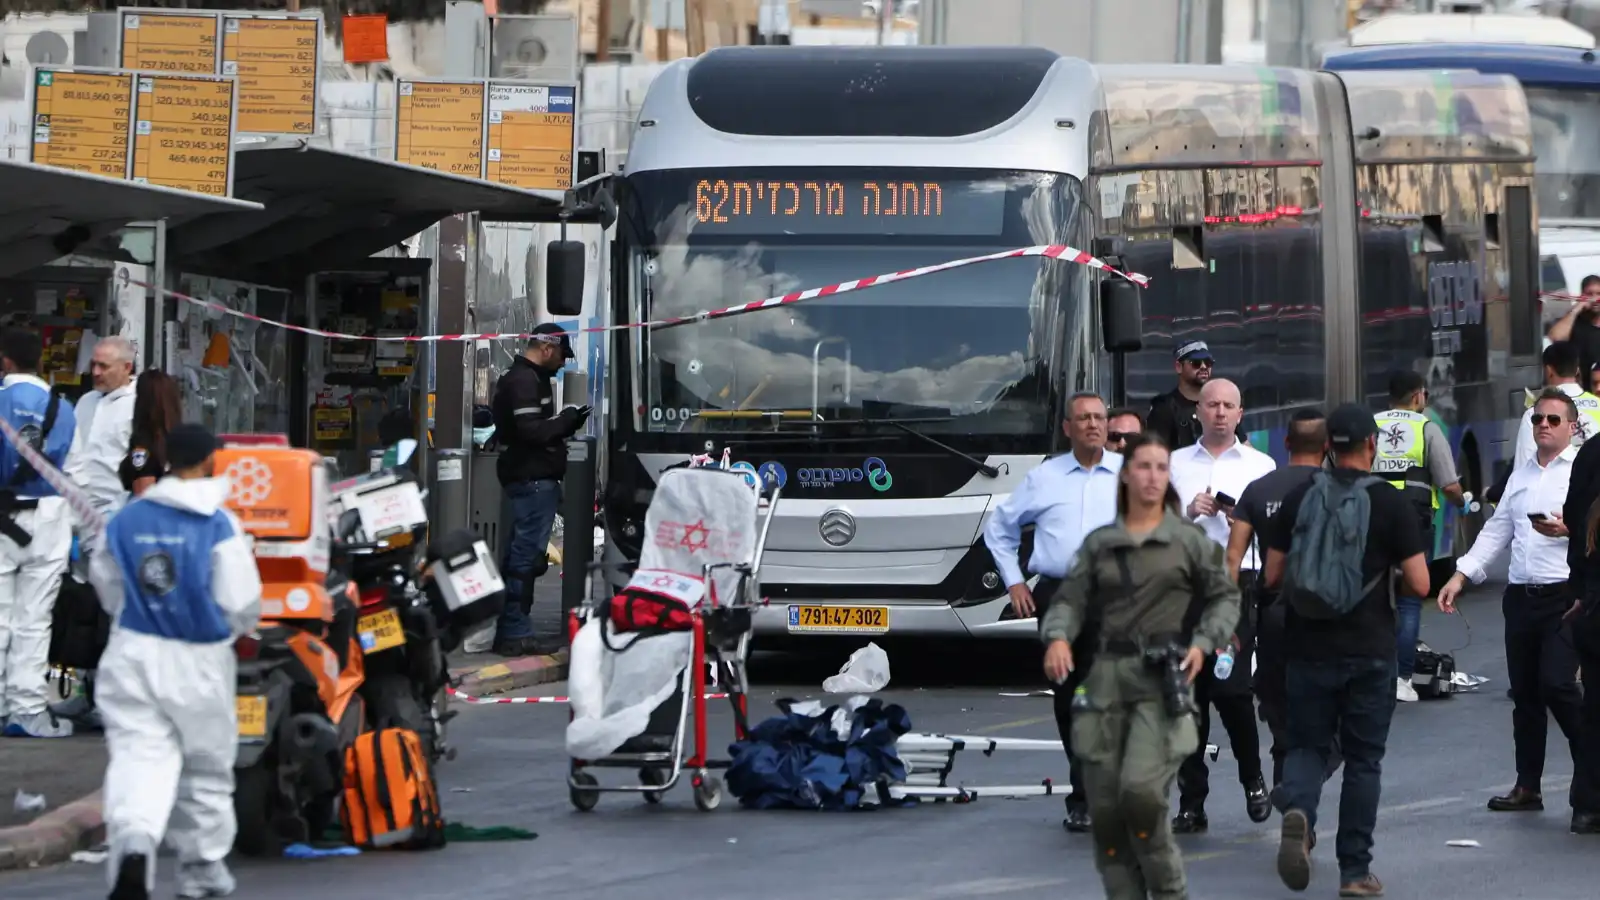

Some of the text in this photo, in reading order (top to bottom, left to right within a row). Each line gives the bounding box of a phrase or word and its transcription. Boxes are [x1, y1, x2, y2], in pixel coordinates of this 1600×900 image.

[302, 80, 312, 88] 36
[471, 112, 480, 120] 57
[560, 153, 570, 162] 62
[554, 166, 570, 175] 506
[696, 180, 942, 222] תחנה מרכזית 62
[797, 467, 864, 482] סופרבוס
